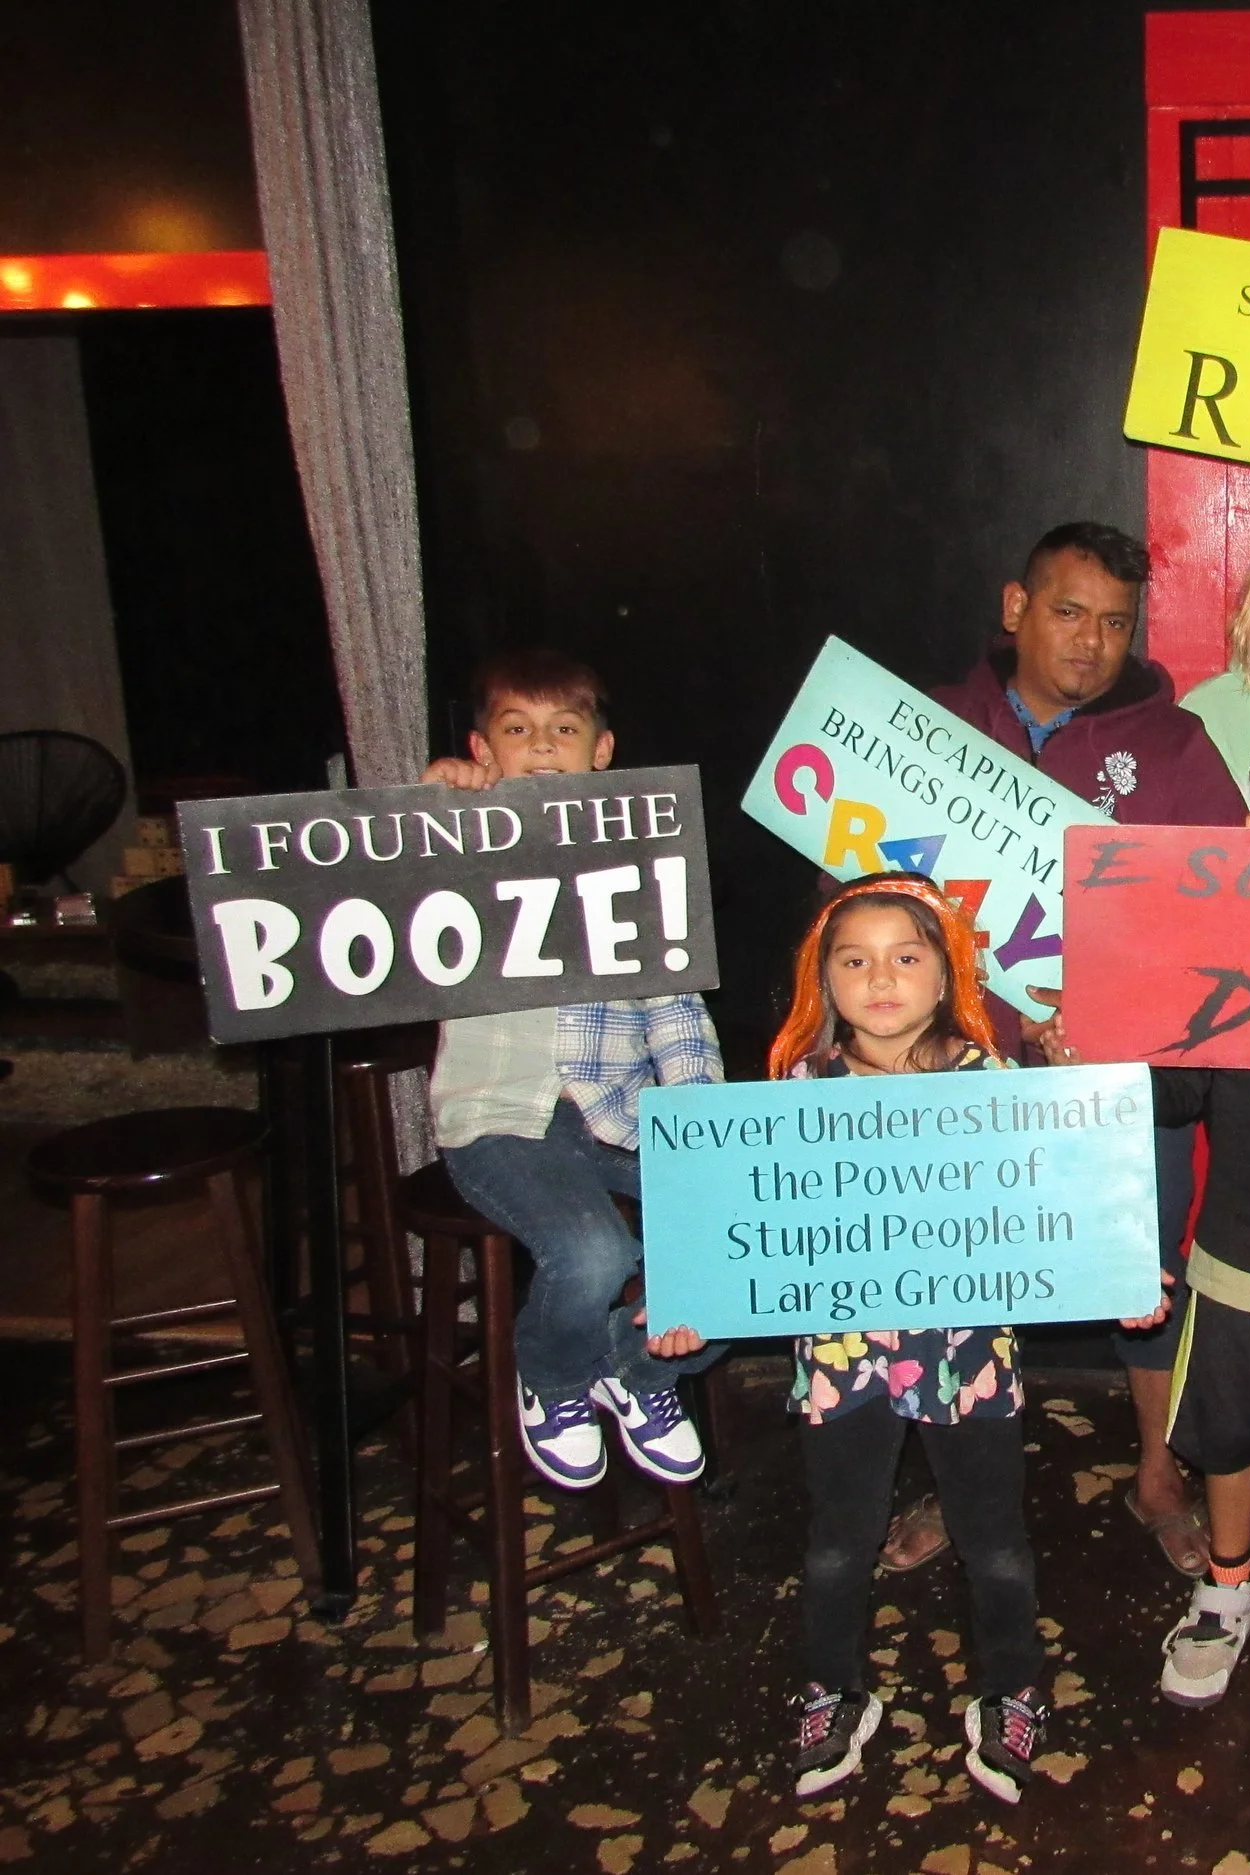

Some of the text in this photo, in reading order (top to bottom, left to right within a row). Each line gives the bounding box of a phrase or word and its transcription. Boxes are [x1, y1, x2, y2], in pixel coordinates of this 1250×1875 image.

[820, 707, 1063, 897] BRINGS OUT M
[887, 699, 1057, 827] ESCAPING
[202, 793, 683, 875] I FOUND THE
[774, 743, 1062, 972] CRAZY
[212, 856, 690, 1011] BOOZE!
[650, 1090, 1138, 1153] Never Underestimate
[748, 1147, 1046, 1203] the Power of
[727, 1204, 1074, 1267] Stupid People in
[749, 1267, 1056, 1321] Large Groups
